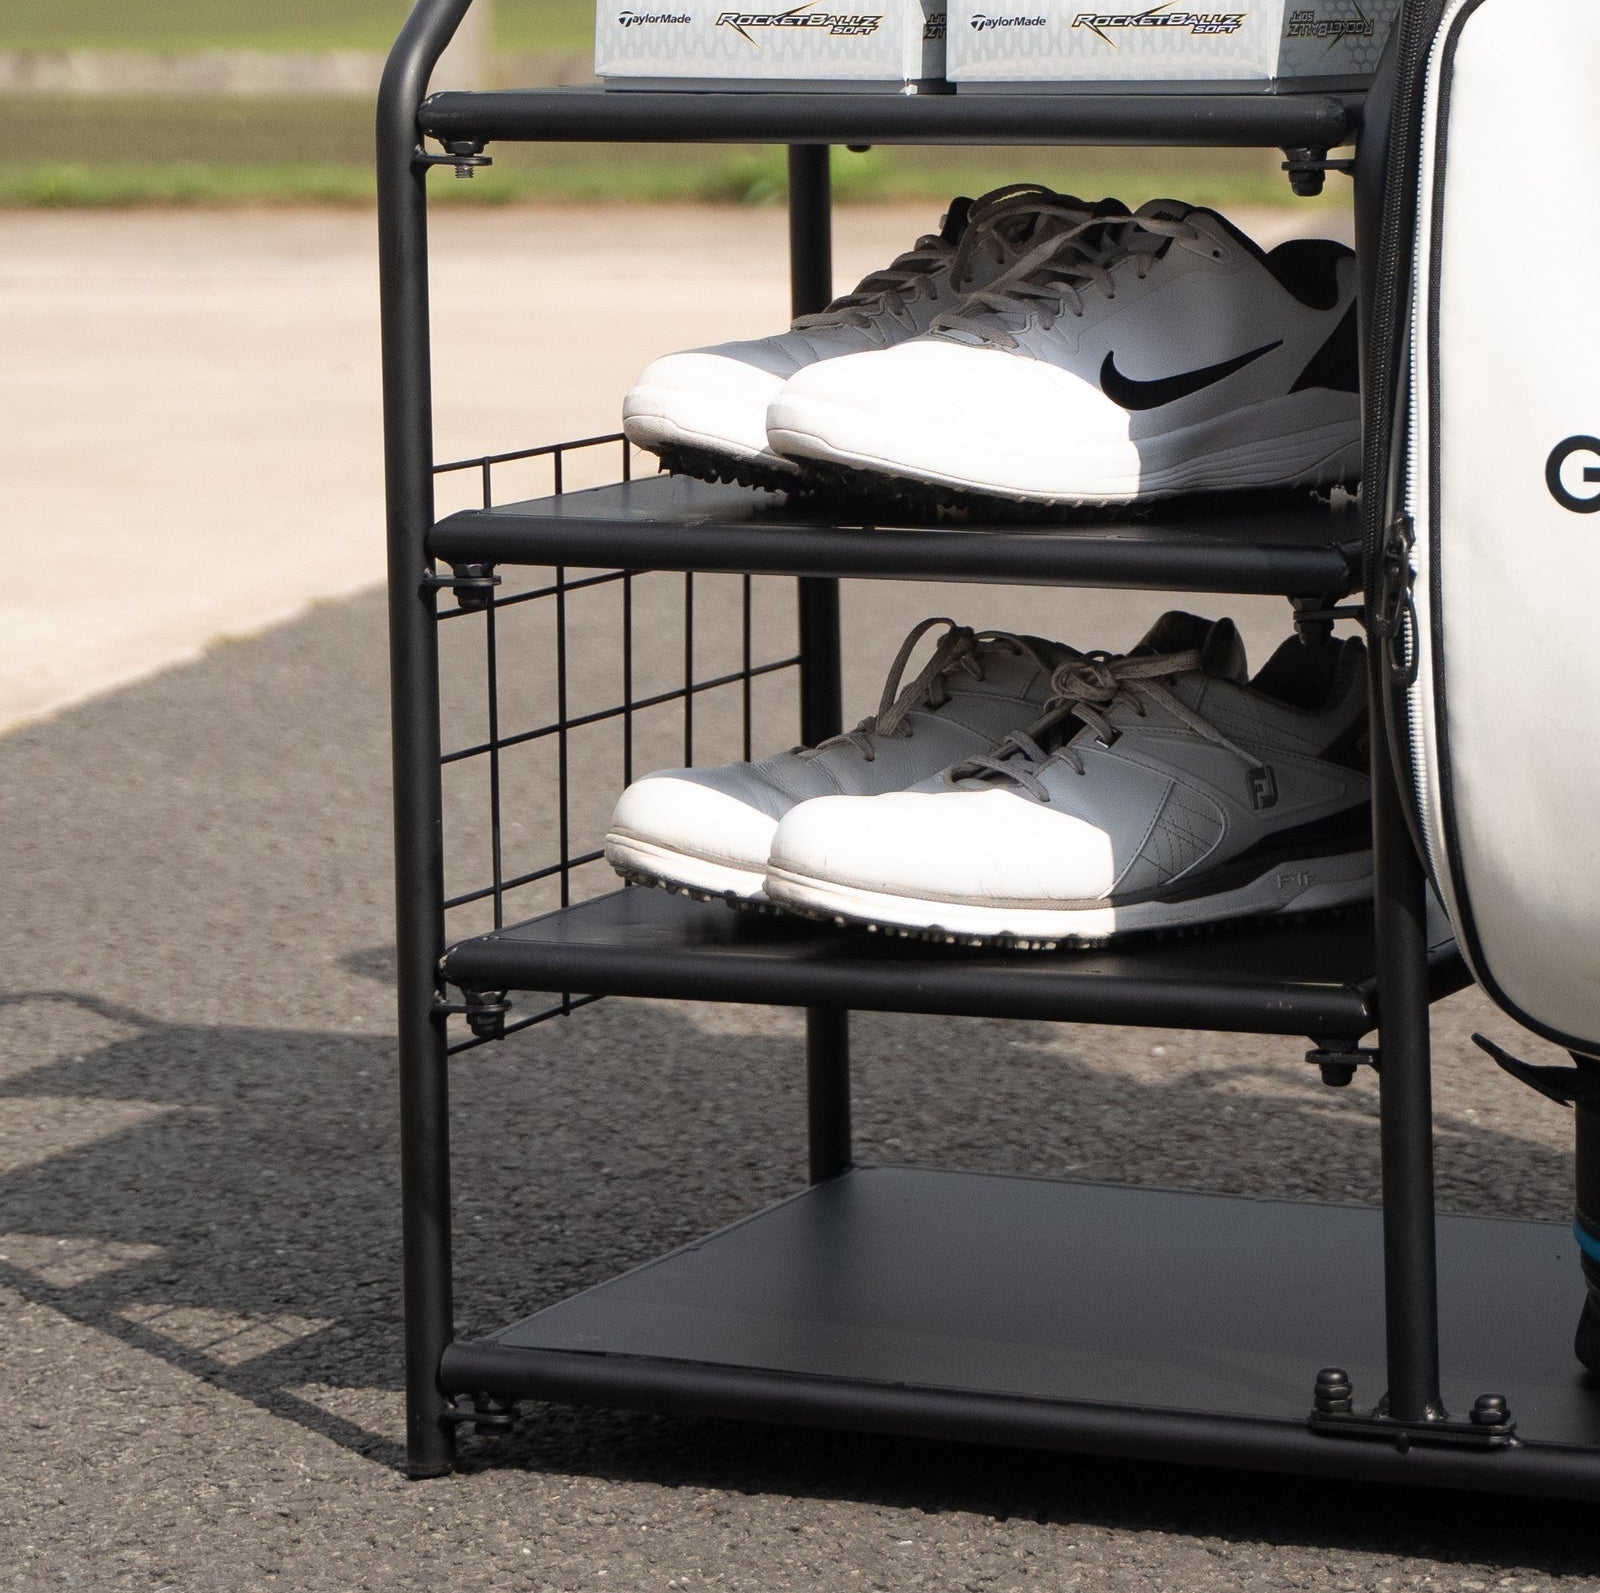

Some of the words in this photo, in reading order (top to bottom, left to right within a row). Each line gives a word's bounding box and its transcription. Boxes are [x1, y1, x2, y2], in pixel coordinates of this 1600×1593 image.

[618, 11, 691, 27] TaylorMade
[970, 14, 1046, 31] TaylorMade
[830, 25, 879, 35] SOFT
[1190, 24, 1243, 35] SOFT
